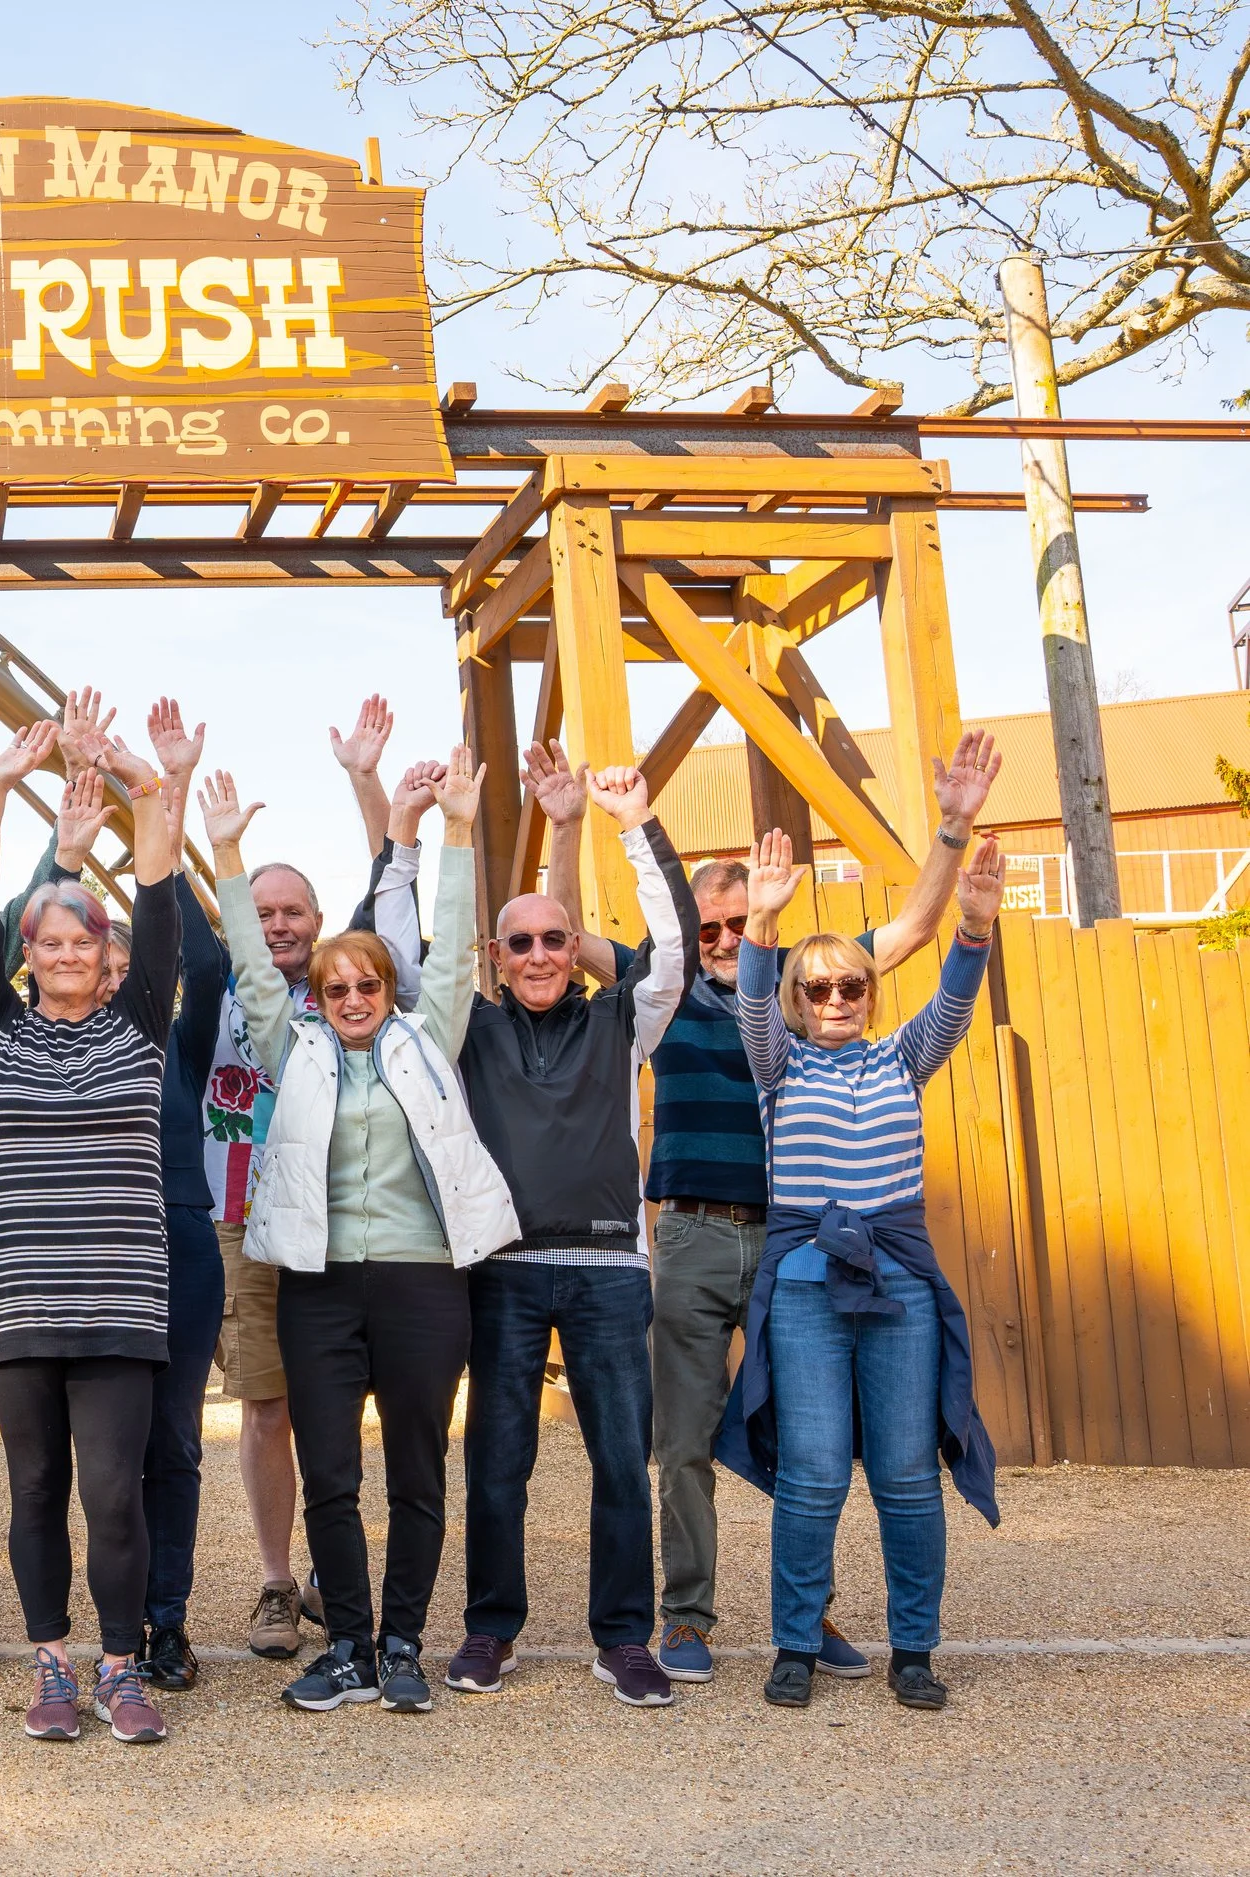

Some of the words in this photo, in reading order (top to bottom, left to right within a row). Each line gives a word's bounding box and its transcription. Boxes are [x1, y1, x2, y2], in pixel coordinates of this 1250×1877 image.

[44, 125, 328, 236] MANOR
[10, 256, 346, 373] RUSH
[260, 405, 350, 445] co.
